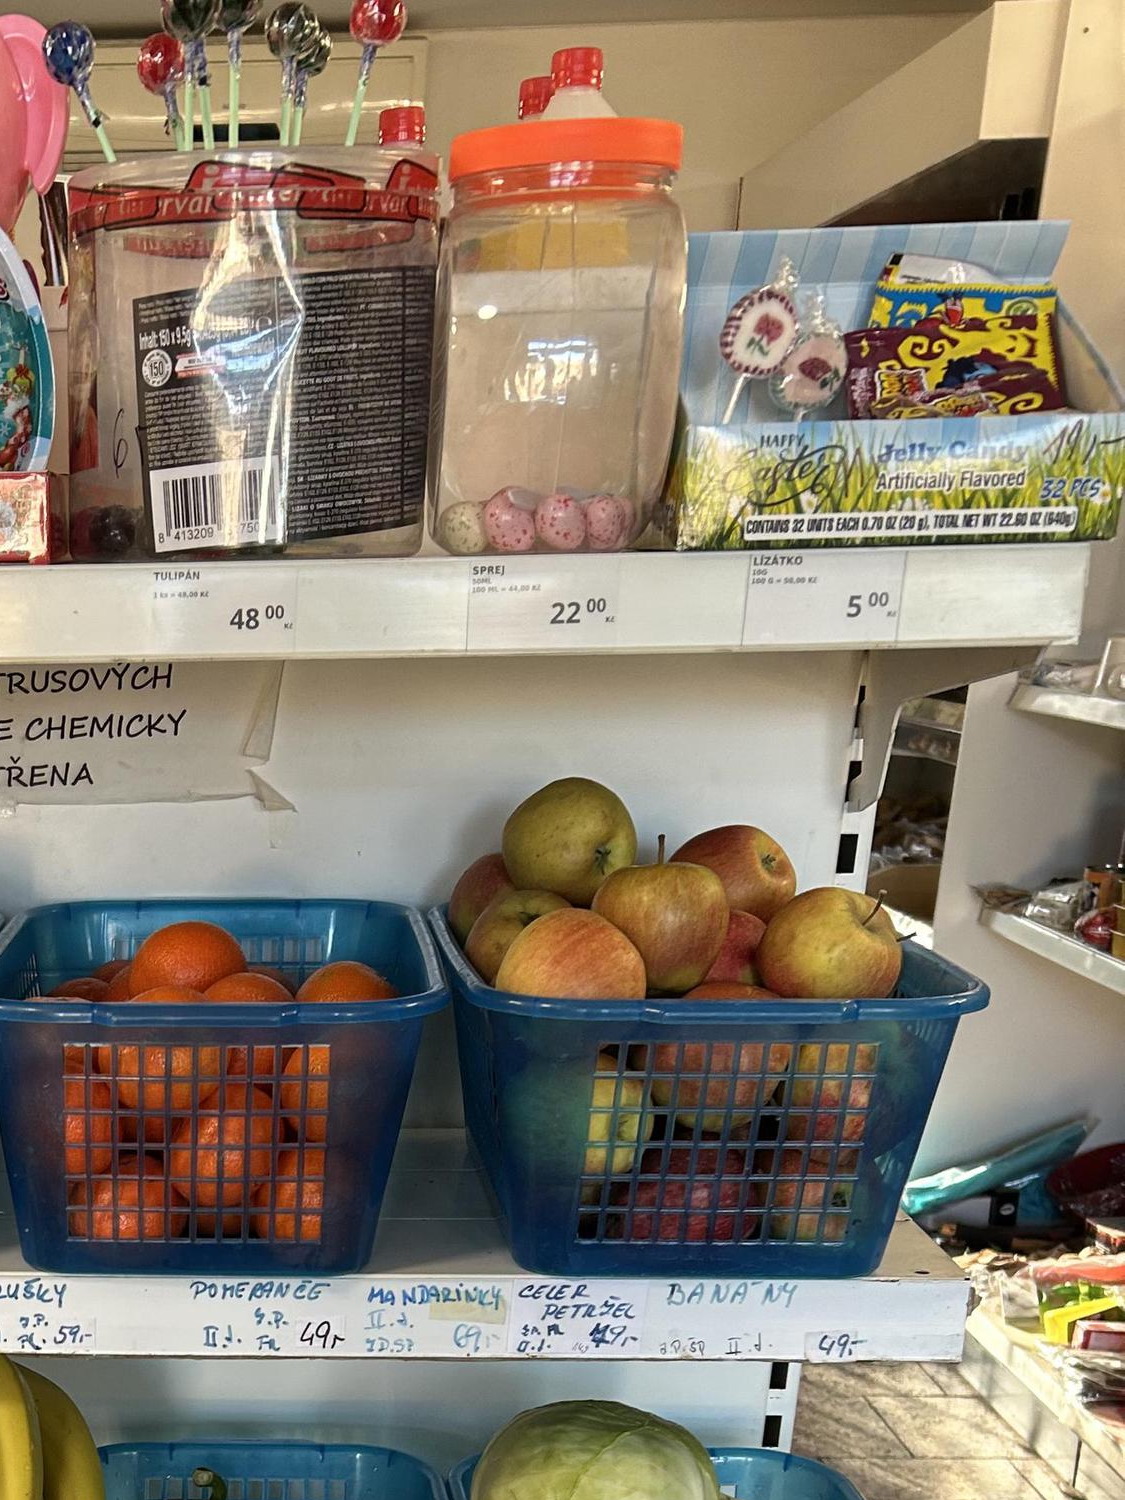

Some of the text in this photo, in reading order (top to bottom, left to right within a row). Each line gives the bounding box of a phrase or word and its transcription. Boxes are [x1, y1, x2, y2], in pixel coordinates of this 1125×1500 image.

[149, 362, 164, 377] 150
[760, 432, 806, 450] HAPPY
[877, 438, 1028, 464] Jelly Candy
[876, 469, 1026, 491] Artificially Flavored
[1039, 476, 1103, 499] 32 PCS
[746, 517, 789, 535] CONTAINS
[792, 518, 804, 533] 32
[806, 516, 834, 532] UNITS
[836, 516, 860, 531] EACH
[862, 515, 882, 530] 0.70
[885, 514, 898, 529] OZ
[933, 512, 959, 528] TOTAL
[962, 512, 980, 527] NET
[982, 512, 997, 526] WT
[1029, 511, 1042, 525] OZ
[158, 533, 165, 544] 8
[173, 526, 214, 542] 413209
[753, 555, 804, 567] LÍZÁTKO
[153, 569, 201, 581] TULIPÁN
[472, 566, 506, 578] SPREJ
[550, 601, 581, 625] 22
[586, 598, 607, 613] 00
[846, 595, 862, 619] 5
[868, 591, 889, 607] 00
[230, 608, 260, 630] 48
[266, 605, 285, 620] 00
[25, 709, 187, 741] CHEMICKY
[190, 1279, 331, 1300] POMERANČE
[518, 1284, 591, 1300] CELER
